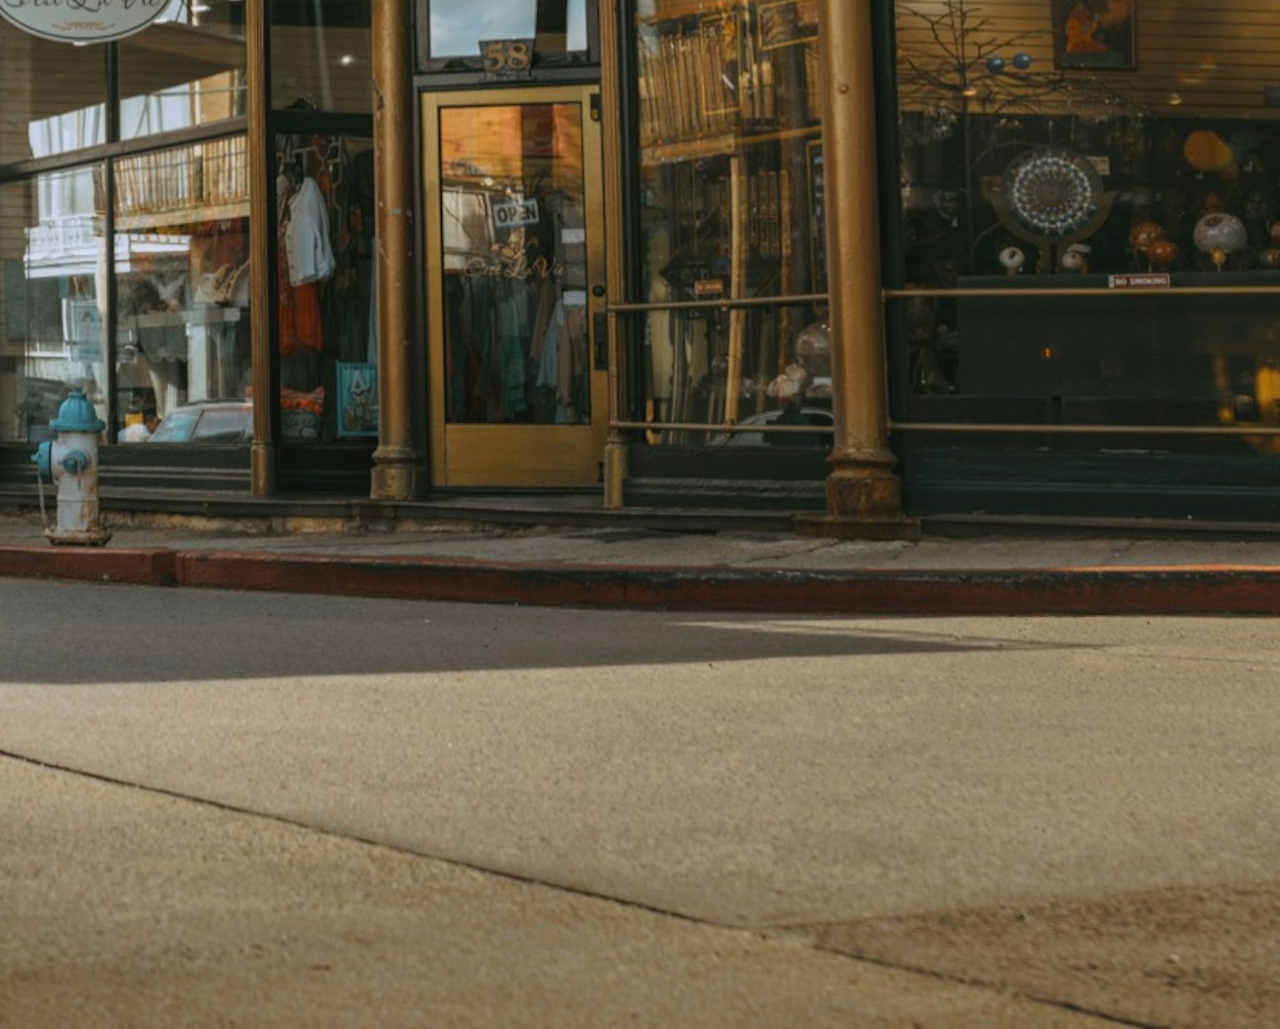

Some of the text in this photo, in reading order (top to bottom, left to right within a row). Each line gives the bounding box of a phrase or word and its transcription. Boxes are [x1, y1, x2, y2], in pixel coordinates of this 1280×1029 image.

[484, 41, 529, 71] 58
[497, 204, 536, 223] OPEN
[1115, 277, 1167, 286] NO SMOKING
